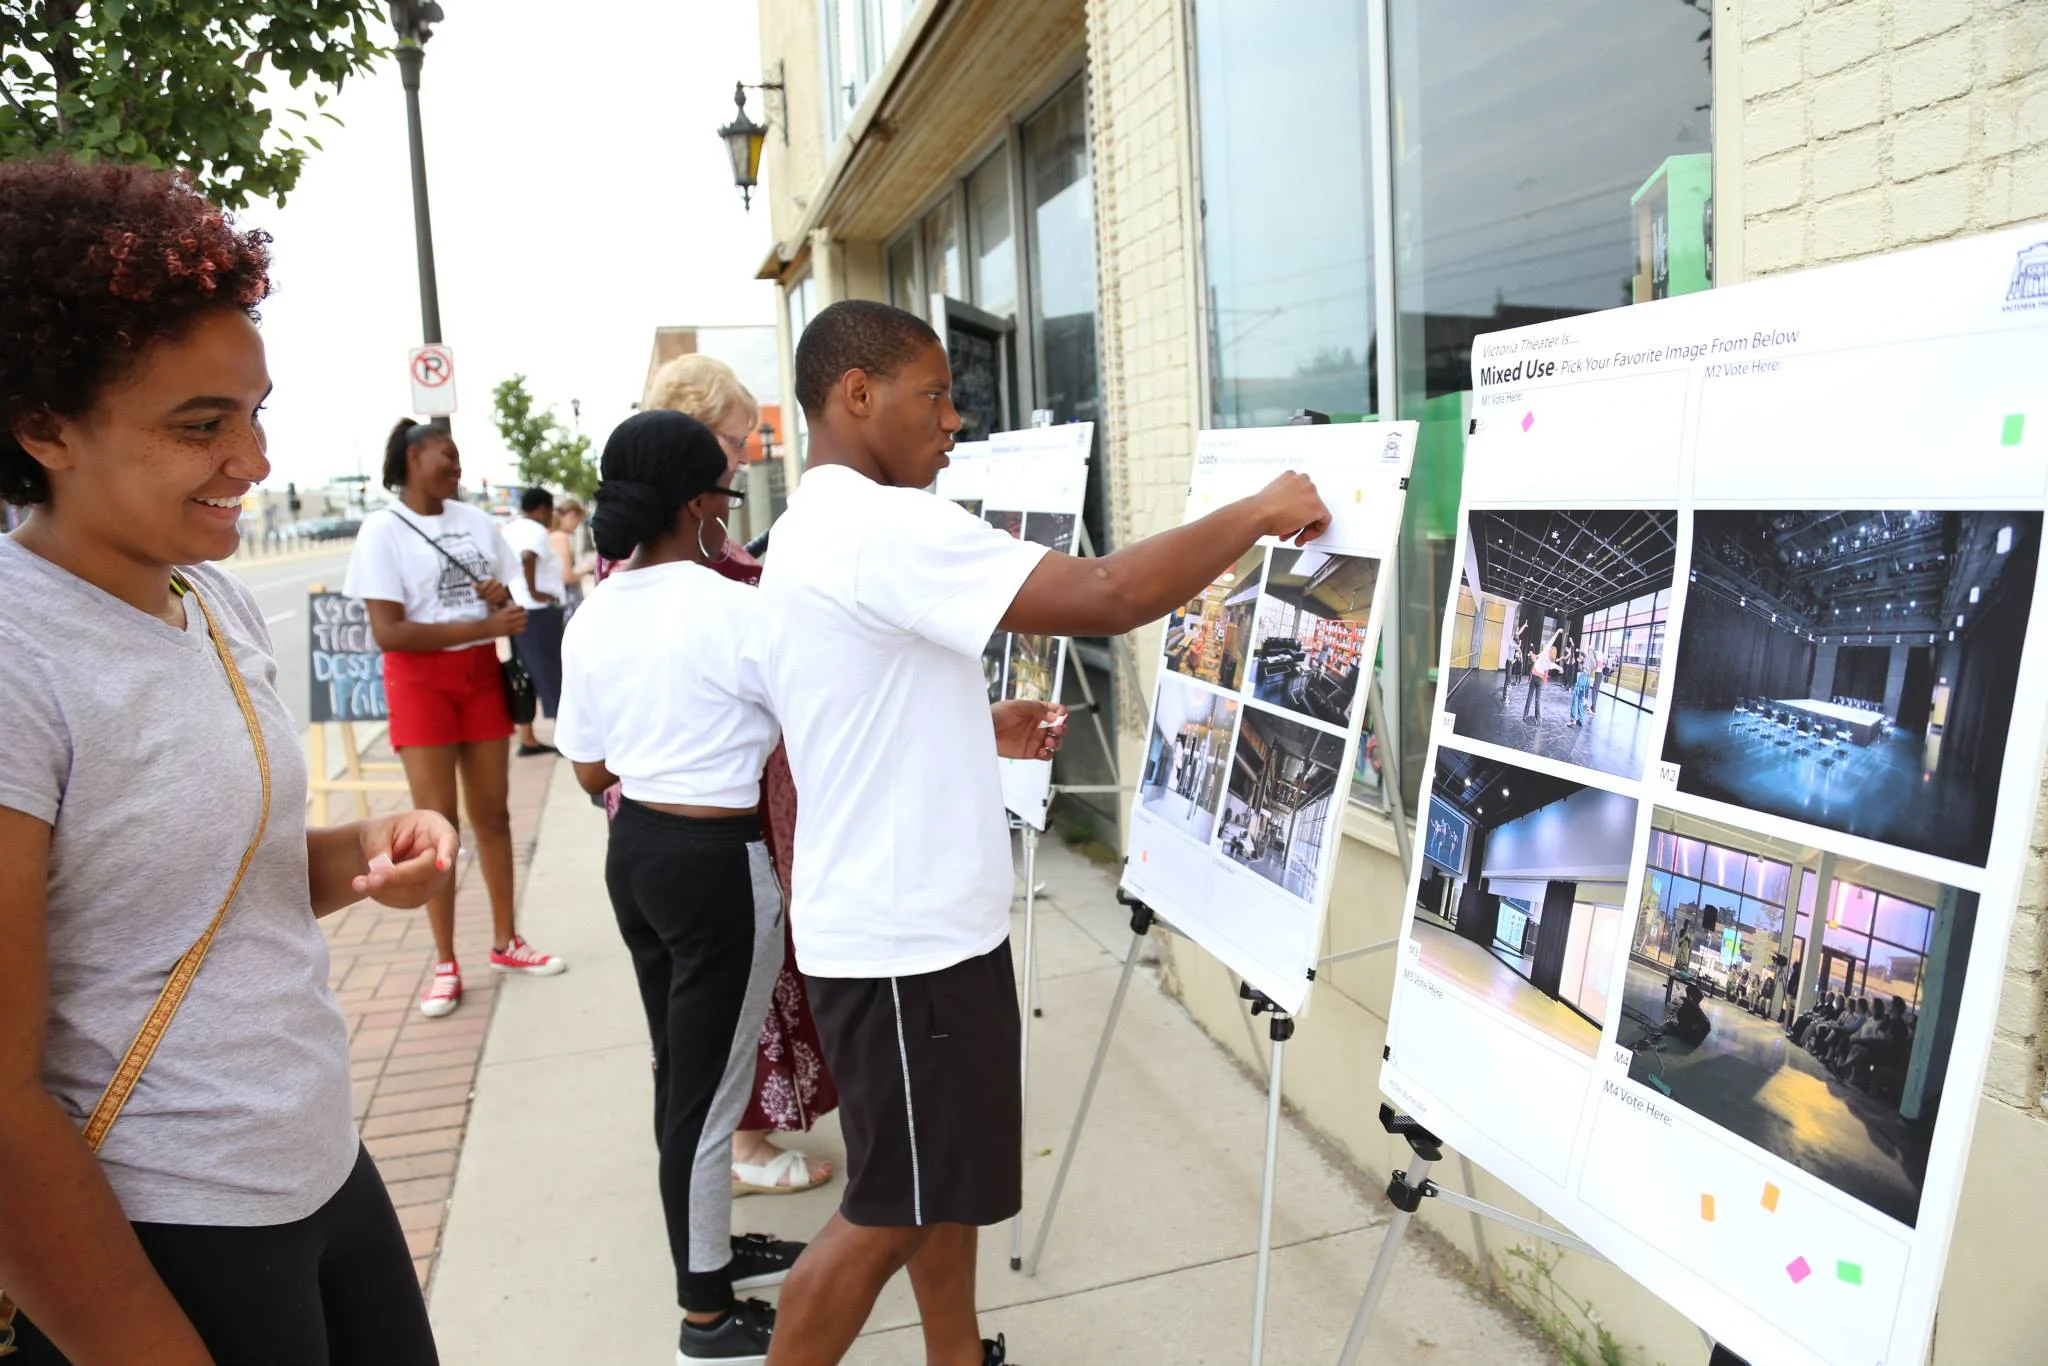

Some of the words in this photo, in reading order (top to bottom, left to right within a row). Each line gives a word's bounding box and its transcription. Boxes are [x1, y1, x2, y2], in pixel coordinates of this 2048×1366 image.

[1482, 344, 1518, 358] Victoria
[1521, 336, 1560, 353] Theater
[1480, 360, 1523, 388] Mixed
[1560, 358, 1582, 375] Pick
[1585, 356, 1611, 372] Your
[1613, 348, 1663, 368] Favorite
[1665, 343, 1708, 362] Image
[1711, 337, 1748, 354] From
[1752, 328, 1800, 350] Below
[1704, 364, 1722, 379] M2
[1724, 362, 1749, 377] Vote
[1751, 359, 1782, 374] Here:
[1492, 392, 1506, 406] Vote
[1659, 767, 1676, 782] M2
[1414, 973, 1428, 990] Vote
[1613, 1051, 1629, 1067] M4
[1603, 1079, 1619, 1097] M4
[1620, 1087, 1644, 1111] Vote
[1645, 1101, 1673, 1127] Here:
